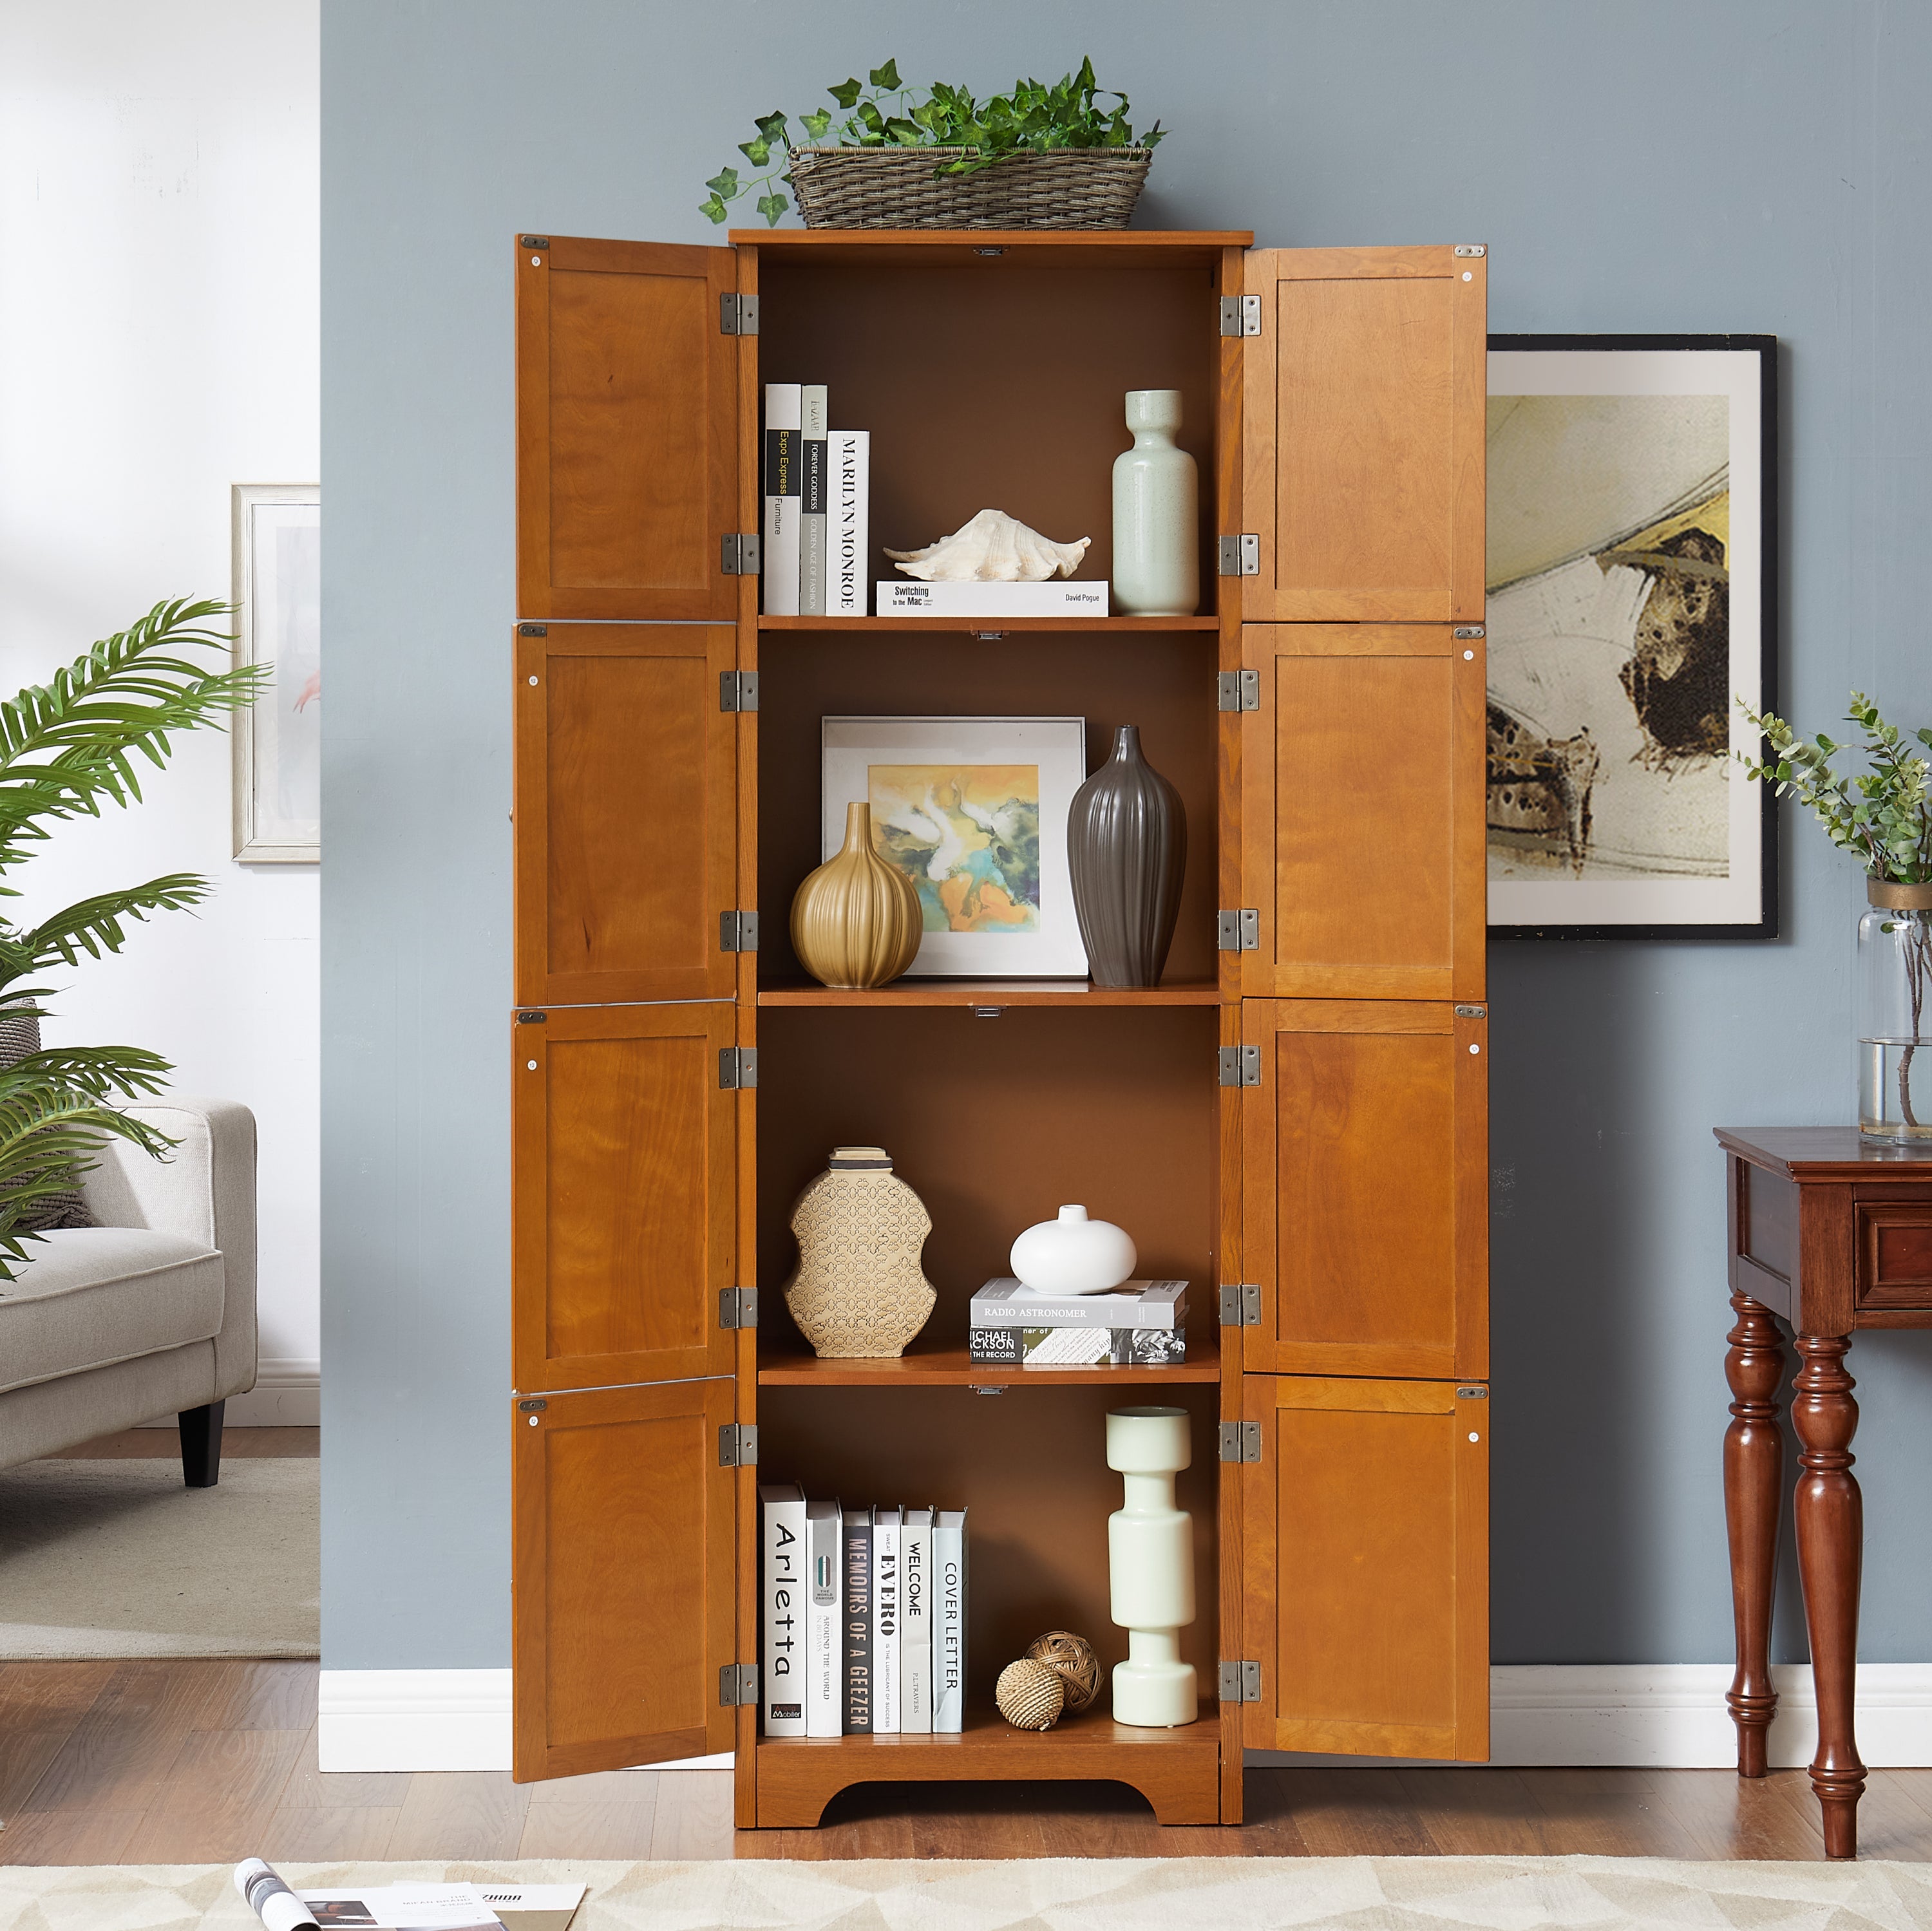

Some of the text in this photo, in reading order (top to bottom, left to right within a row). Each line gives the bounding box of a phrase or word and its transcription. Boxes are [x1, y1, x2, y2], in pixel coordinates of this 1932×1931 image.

[778, 431, 790, 495] Expo Express
[810, 444, 819, 510] FOREVER GODDESS
[774, 498, 782, 535] Furniture
[840, 438, 856, 608] MARILYN MONROE
[810, 567, 817, 576] OF
[895, 586, 929, 597] Switching
[907, 597, 922, 605] Mac
[1082, 594, 1099, 603] Pogue
[970, 1340, 1014, 1350] CKSON
[985, 1308, 1087, 1318] RADIO ASTRONOMER
[775, 1523, 797, 1677] Arletta
[880, 1554, 895, 1636] EVERO
[909, 1541, 921, 1616] WELCOME
[849, 1538, 869, 1726] MEMOIRS OF A GEEZER
[945, 1563, 958, 1689] COVER LETTER
